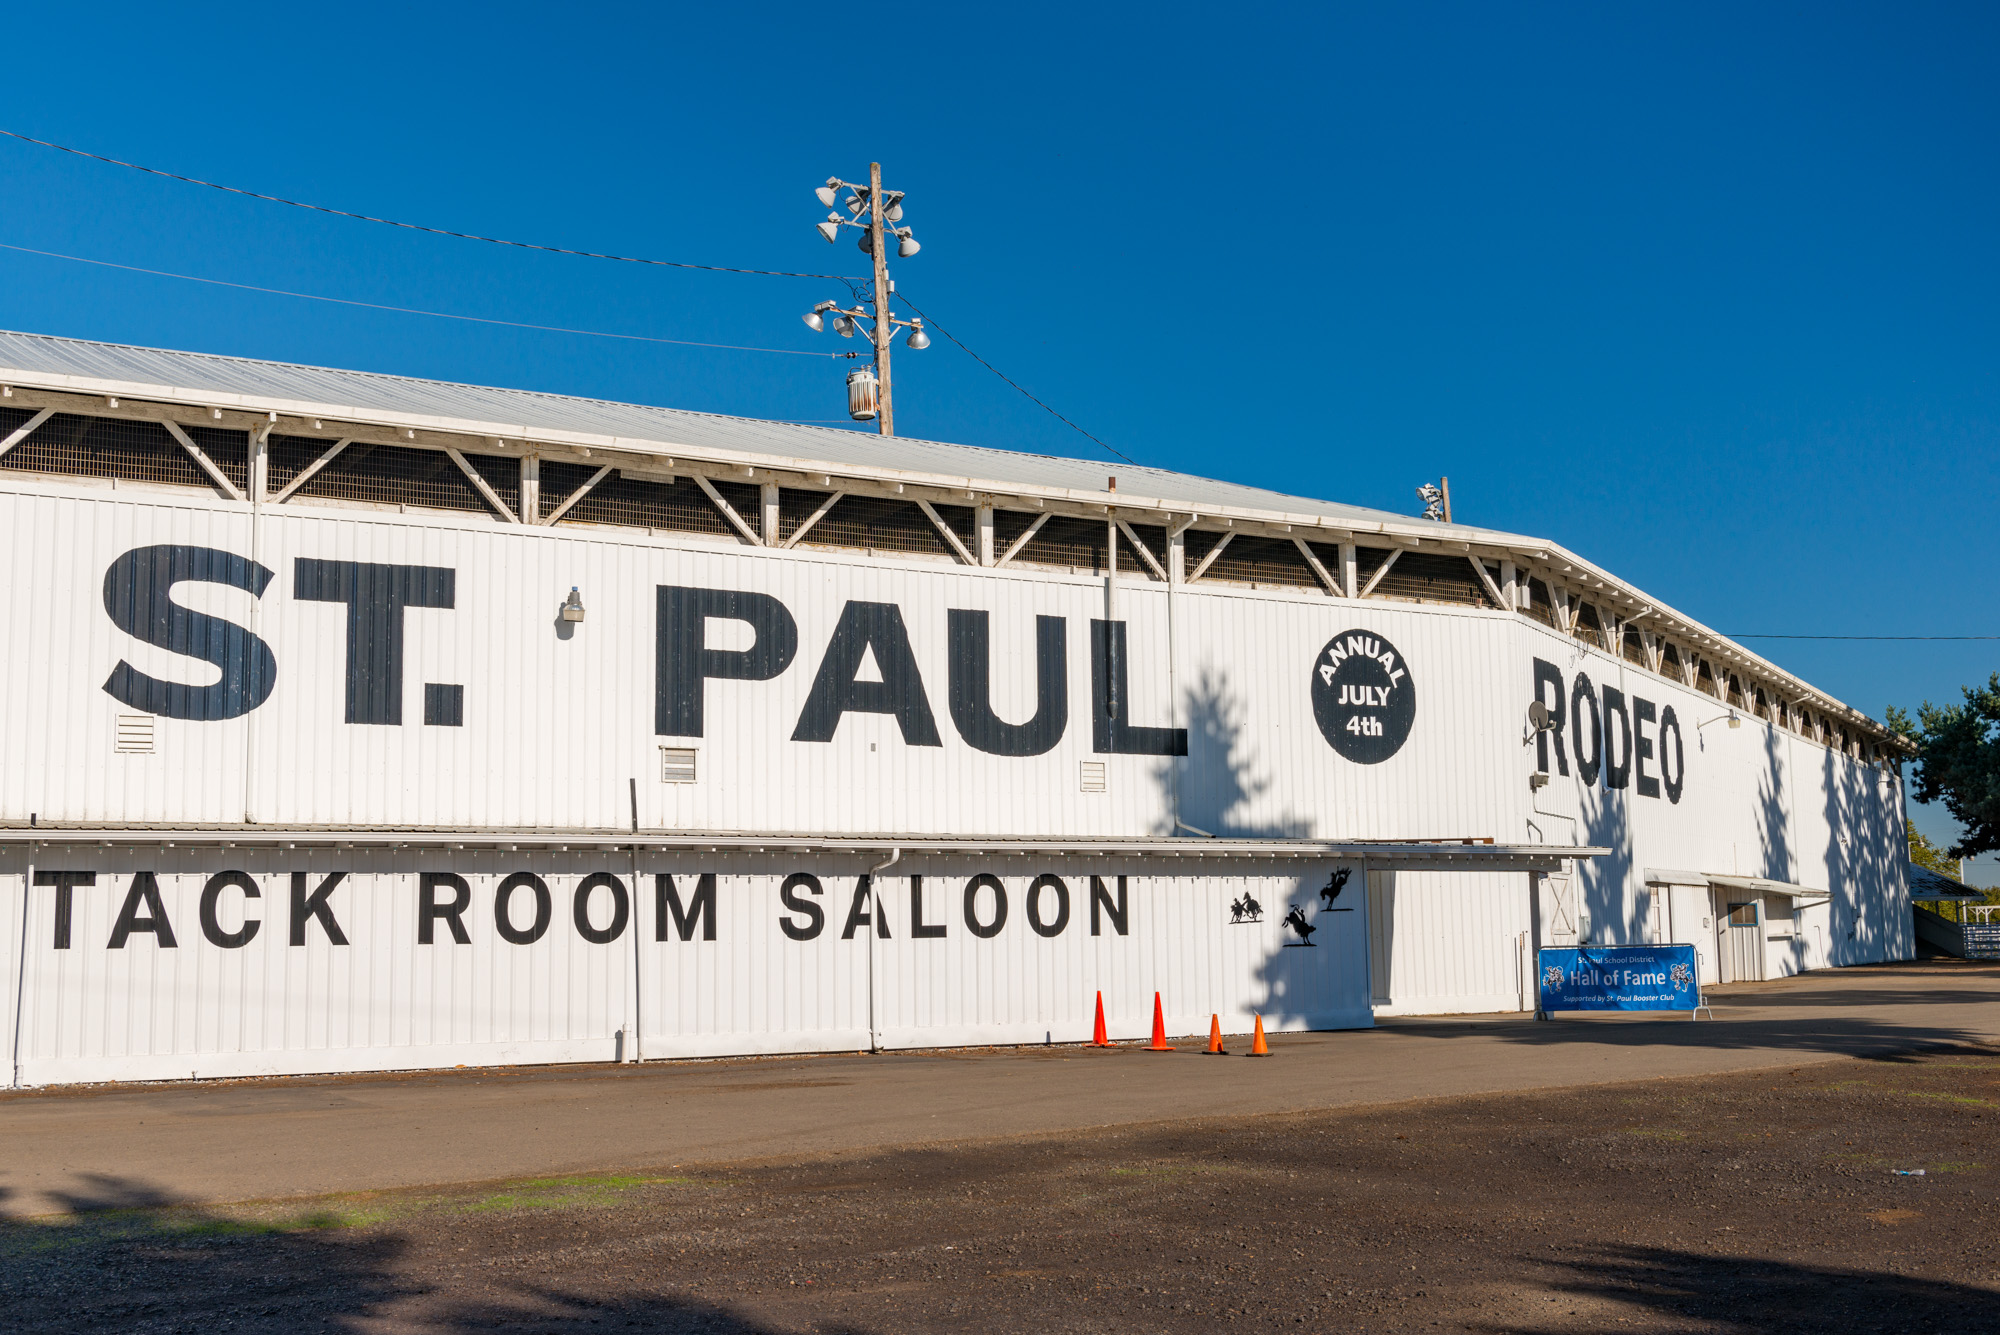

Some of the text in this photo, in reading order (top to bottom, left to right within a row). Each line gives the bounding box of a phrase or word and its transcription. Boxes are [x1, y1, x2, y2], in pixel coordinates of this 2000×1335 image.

[101, 543, 1189, 758] ST. PAUL
[1318, 635, 1406, 689] ANNUAL
[1337, 684, 1391, 707] JULY
[1346, 715, 1383, 737] 4th
[1532, 656, 1684, 805] RODEO
[33, 870, 1129, 950] TACK ROOM SALOON
[1604, 956, 1628, 964] School
[1629, 955, 1655, 963] District
[1570, 969, 1666, 986] Hall of Fame
[1563, 993, 1675, 1003] Supported by St. Paul Booster Club
